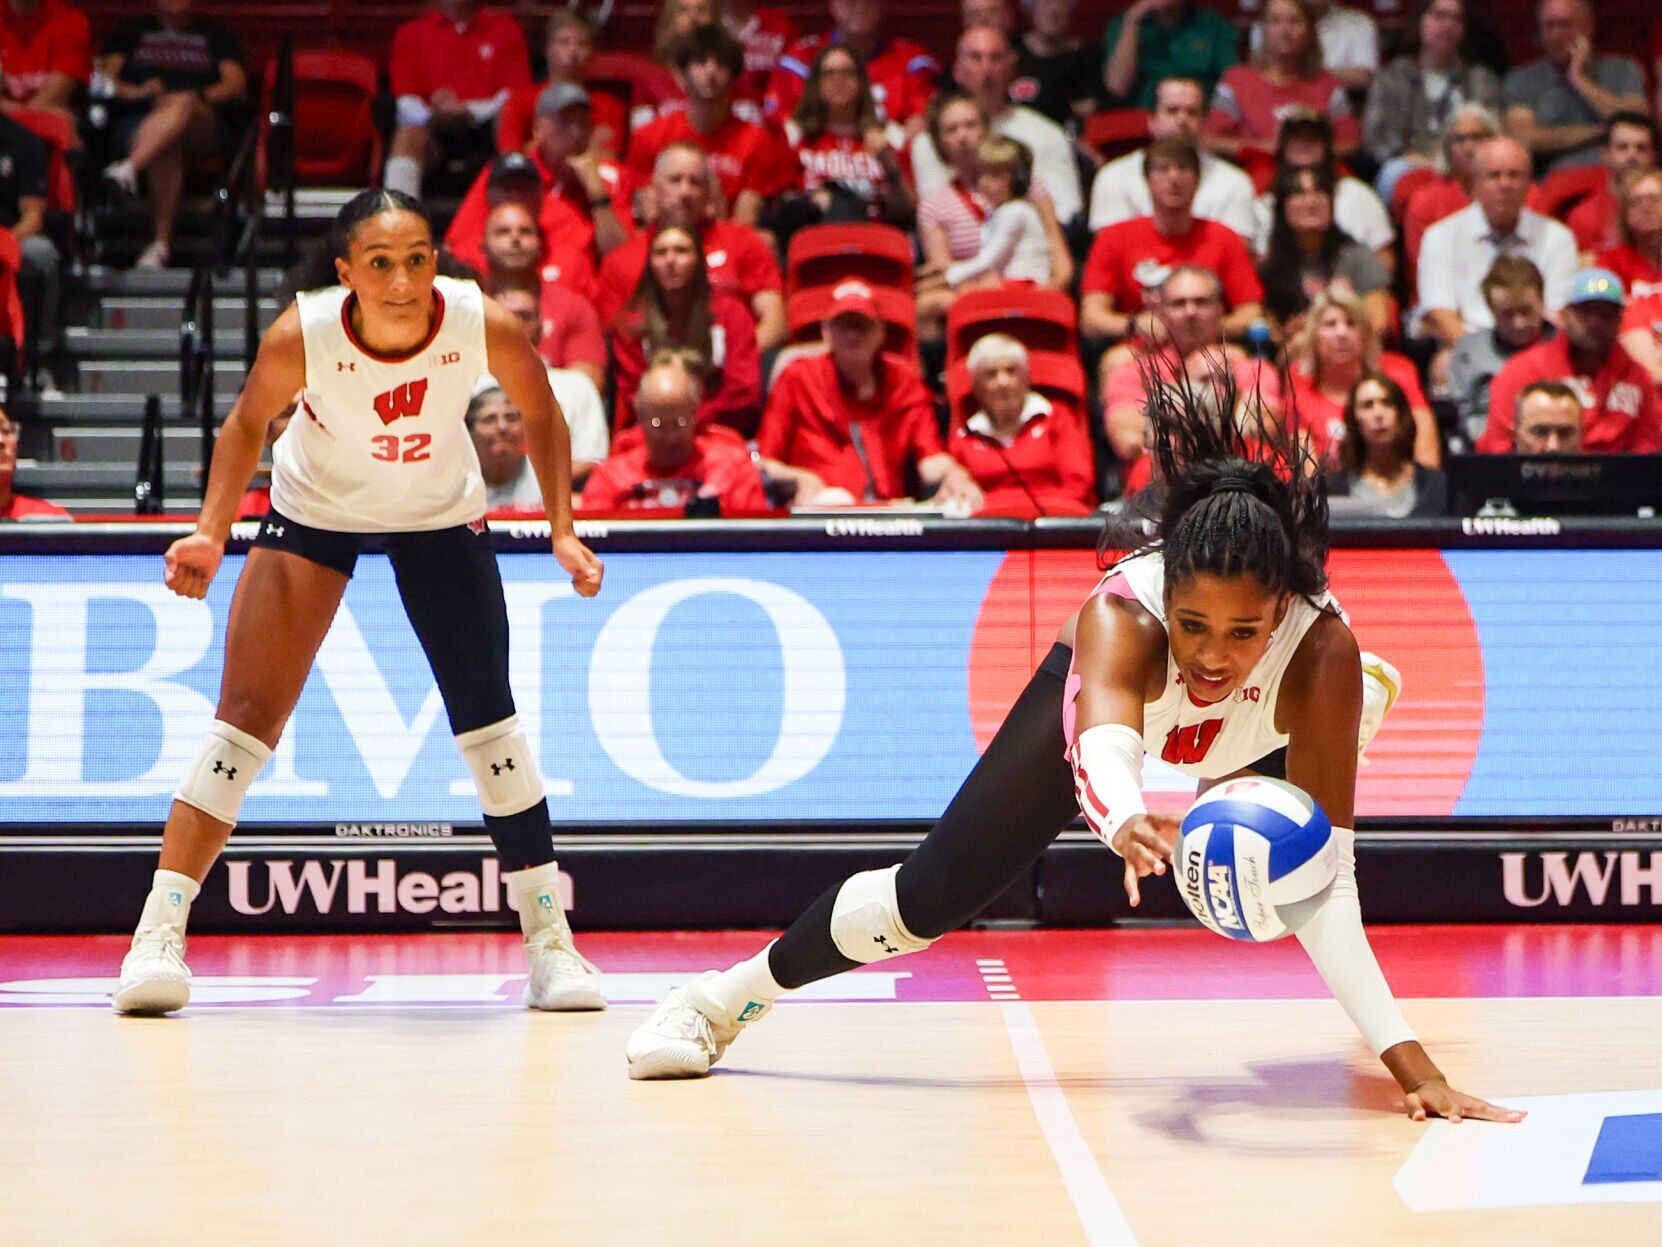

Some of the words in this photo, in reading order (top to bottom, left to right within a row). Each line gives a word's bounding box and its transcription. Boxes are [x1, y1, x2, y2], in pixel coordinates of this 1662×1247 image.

[373, 377, 428, 426] W
[371, 433, 432, 464] 32
[1161, 718, 1224, 765] W
[335, 823, 453, 837] DAKTRONICS
[1185, 850, 1215, 927] molten
[1207, 864, 1246, 930] NCAA
